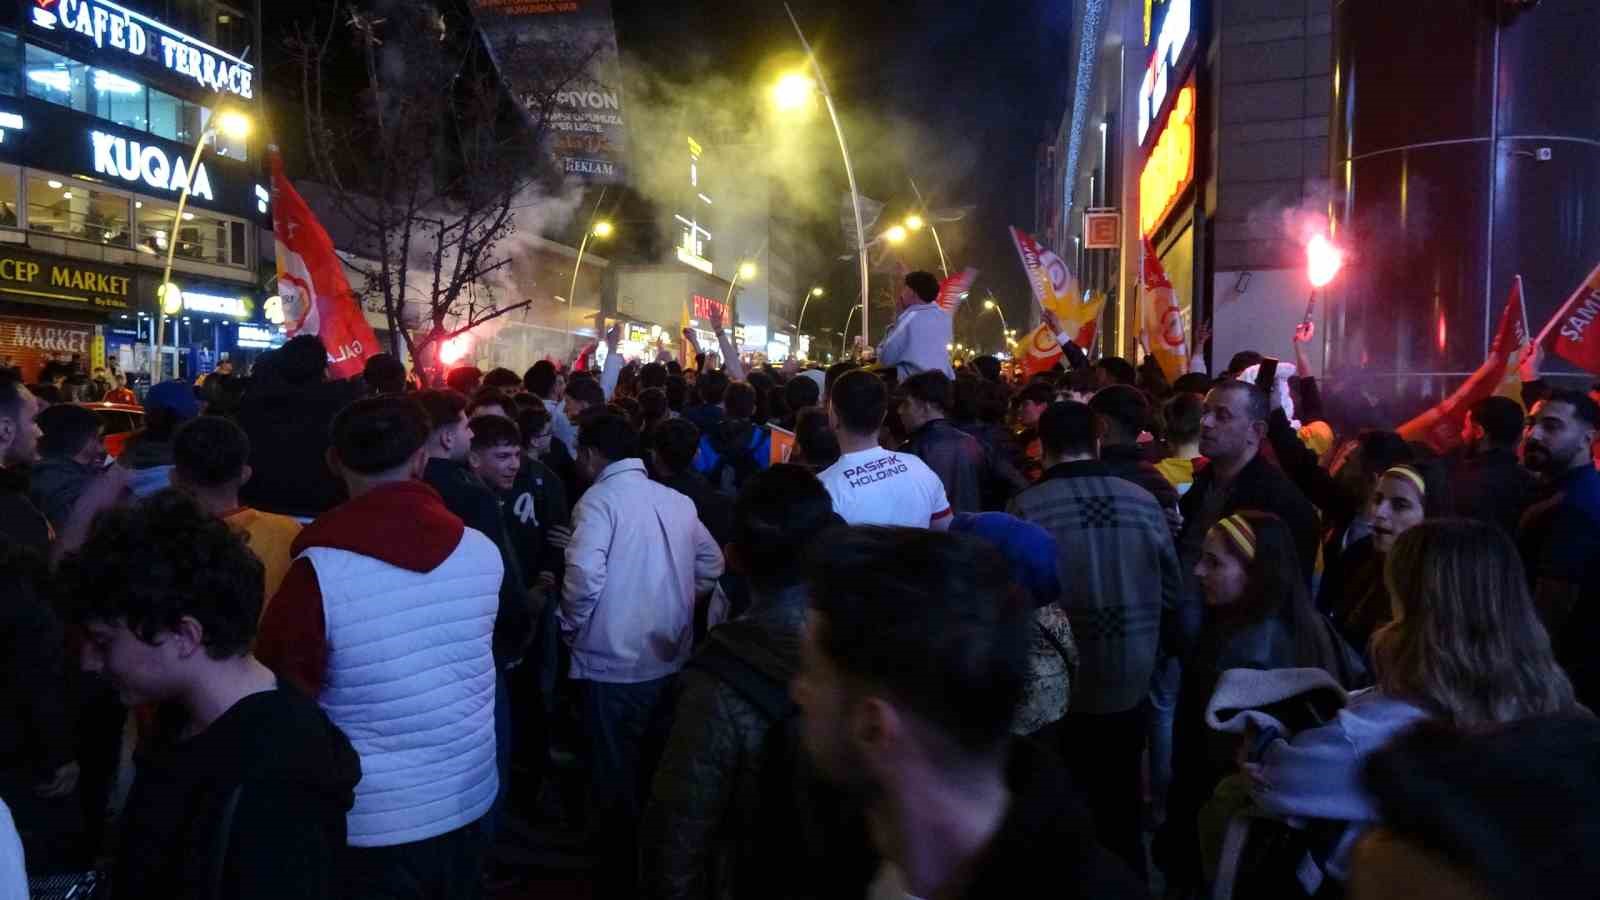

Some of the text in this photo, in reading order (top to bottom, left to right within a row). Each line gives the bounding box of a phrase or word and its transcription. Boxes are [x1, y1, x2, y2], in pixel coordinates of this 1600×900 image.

[161, 36, 253, 99] TERRACE
[92, 131, 213, 200] KUQAA
[0, 259, 129, 295] CEP MARKET
[14, 324, 89, 353] MARKET
